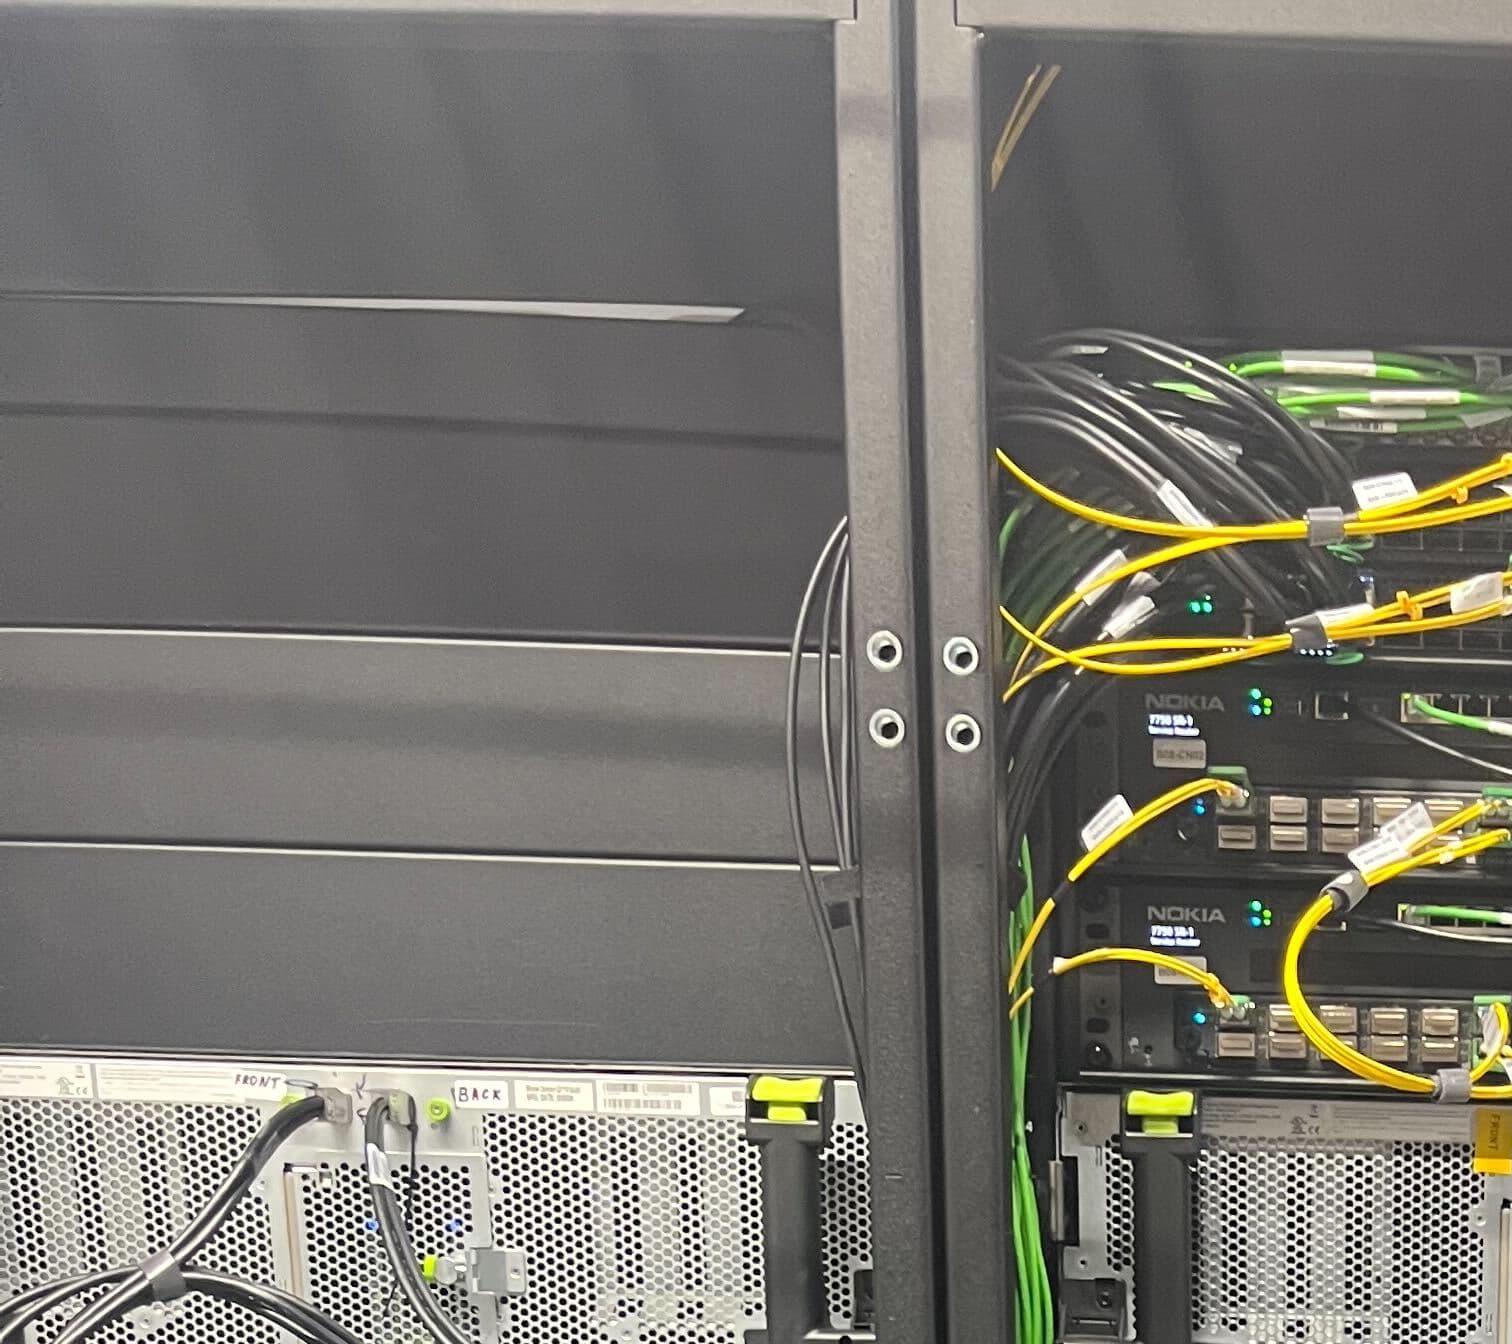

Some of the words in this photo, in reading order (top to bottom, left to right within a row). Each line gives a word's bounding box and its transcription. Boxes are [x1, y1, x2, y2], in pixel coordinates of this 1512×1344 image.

[1144, 693, 1225, 712] NOKIA
[1147, 906, 1226, 923] NOKIA
[234, 1073, 282, 1089] FRONT
[458, 1086, 502, 1102] BACK
